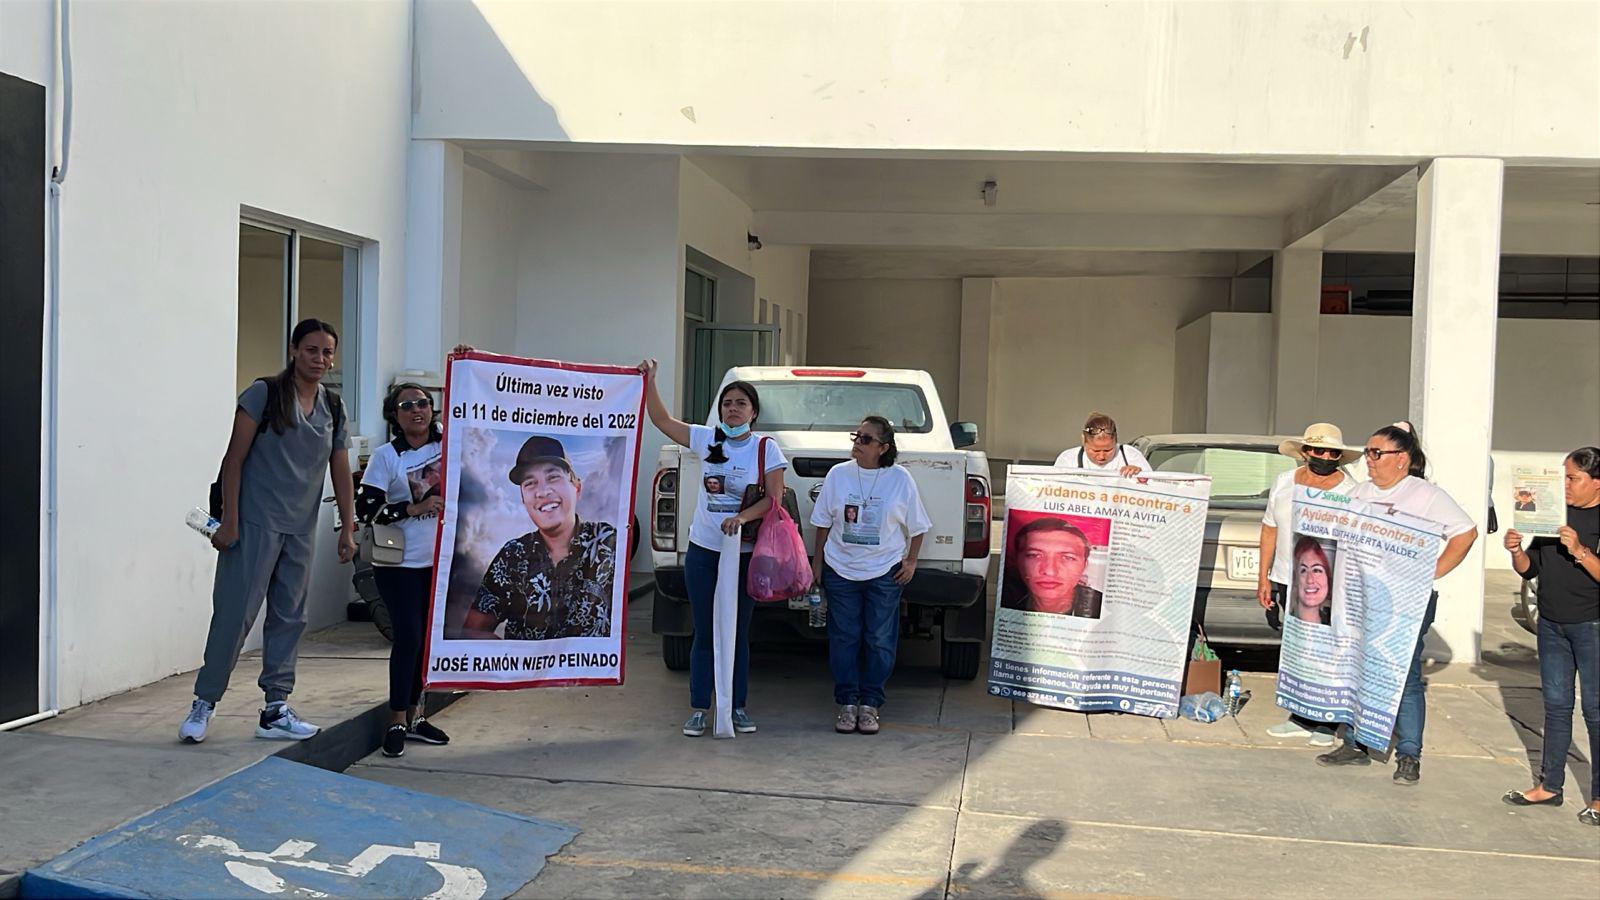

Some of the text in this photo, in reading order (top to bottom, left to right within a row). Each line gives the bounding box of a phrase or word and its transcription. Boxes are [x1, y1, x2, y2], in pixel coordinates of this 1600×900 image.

[496, 372, 604, 400] Última vez visto
[453, 402, 636, 429] el 11 de diciembre del 2022
[1034, 483, 1192, 513] yúdanos a encontrar a
[1043, 501, 1167, 524] LUIS ABEL AMAYA AVITIA
[936, 535, 953, 544] SE
[1301, 522, 1329, 535] SANDRA
[1384, 543, 1418, 559] VALDEZ
[1360, 522, 1415, 544] encontrar
[1417, 538, 1425, 547] a
[432, 653, 618, 672] JOSÉ RAMÓN NIETO PEINADO
[1005, 663, 1028, 672] tienes
[1032, 666, 1079, 680] información
[1082, 673, 1111, 681] referente
[993, 670, 1014, 679] llama
[1111, 684, 1129, 692] muy
